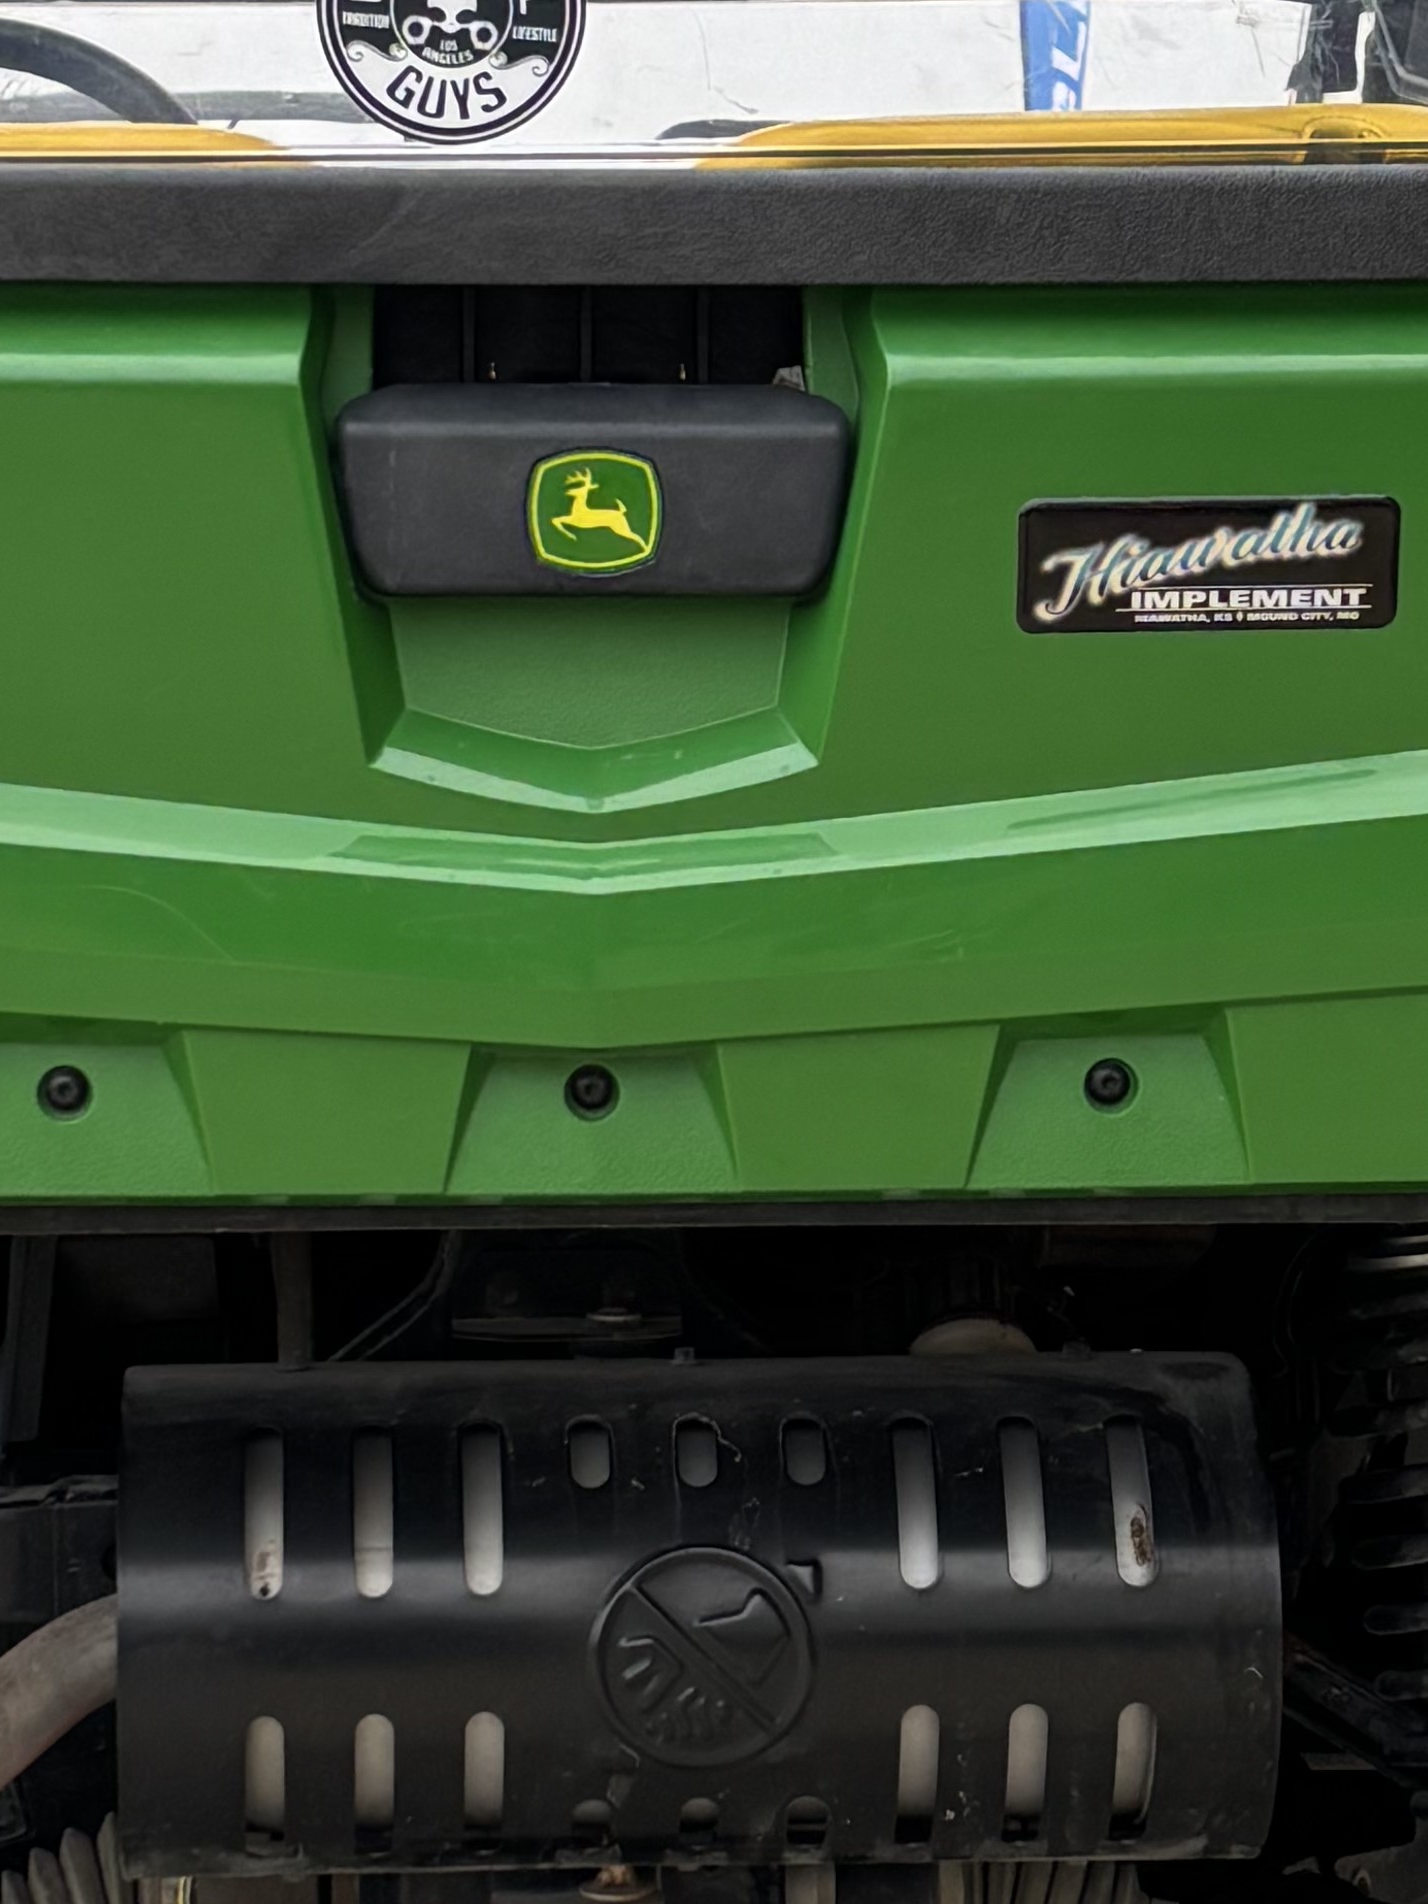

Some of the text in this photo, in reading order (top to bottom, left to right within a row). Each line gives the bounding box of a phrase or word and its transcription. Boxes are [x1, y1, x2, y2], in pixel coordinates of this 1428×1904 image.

[385, 64, 508, 120] GUYS
[1033, 502, 1364, 623] Hiawatha
[1130, 588, 1368, 610] IMPLEMENT
